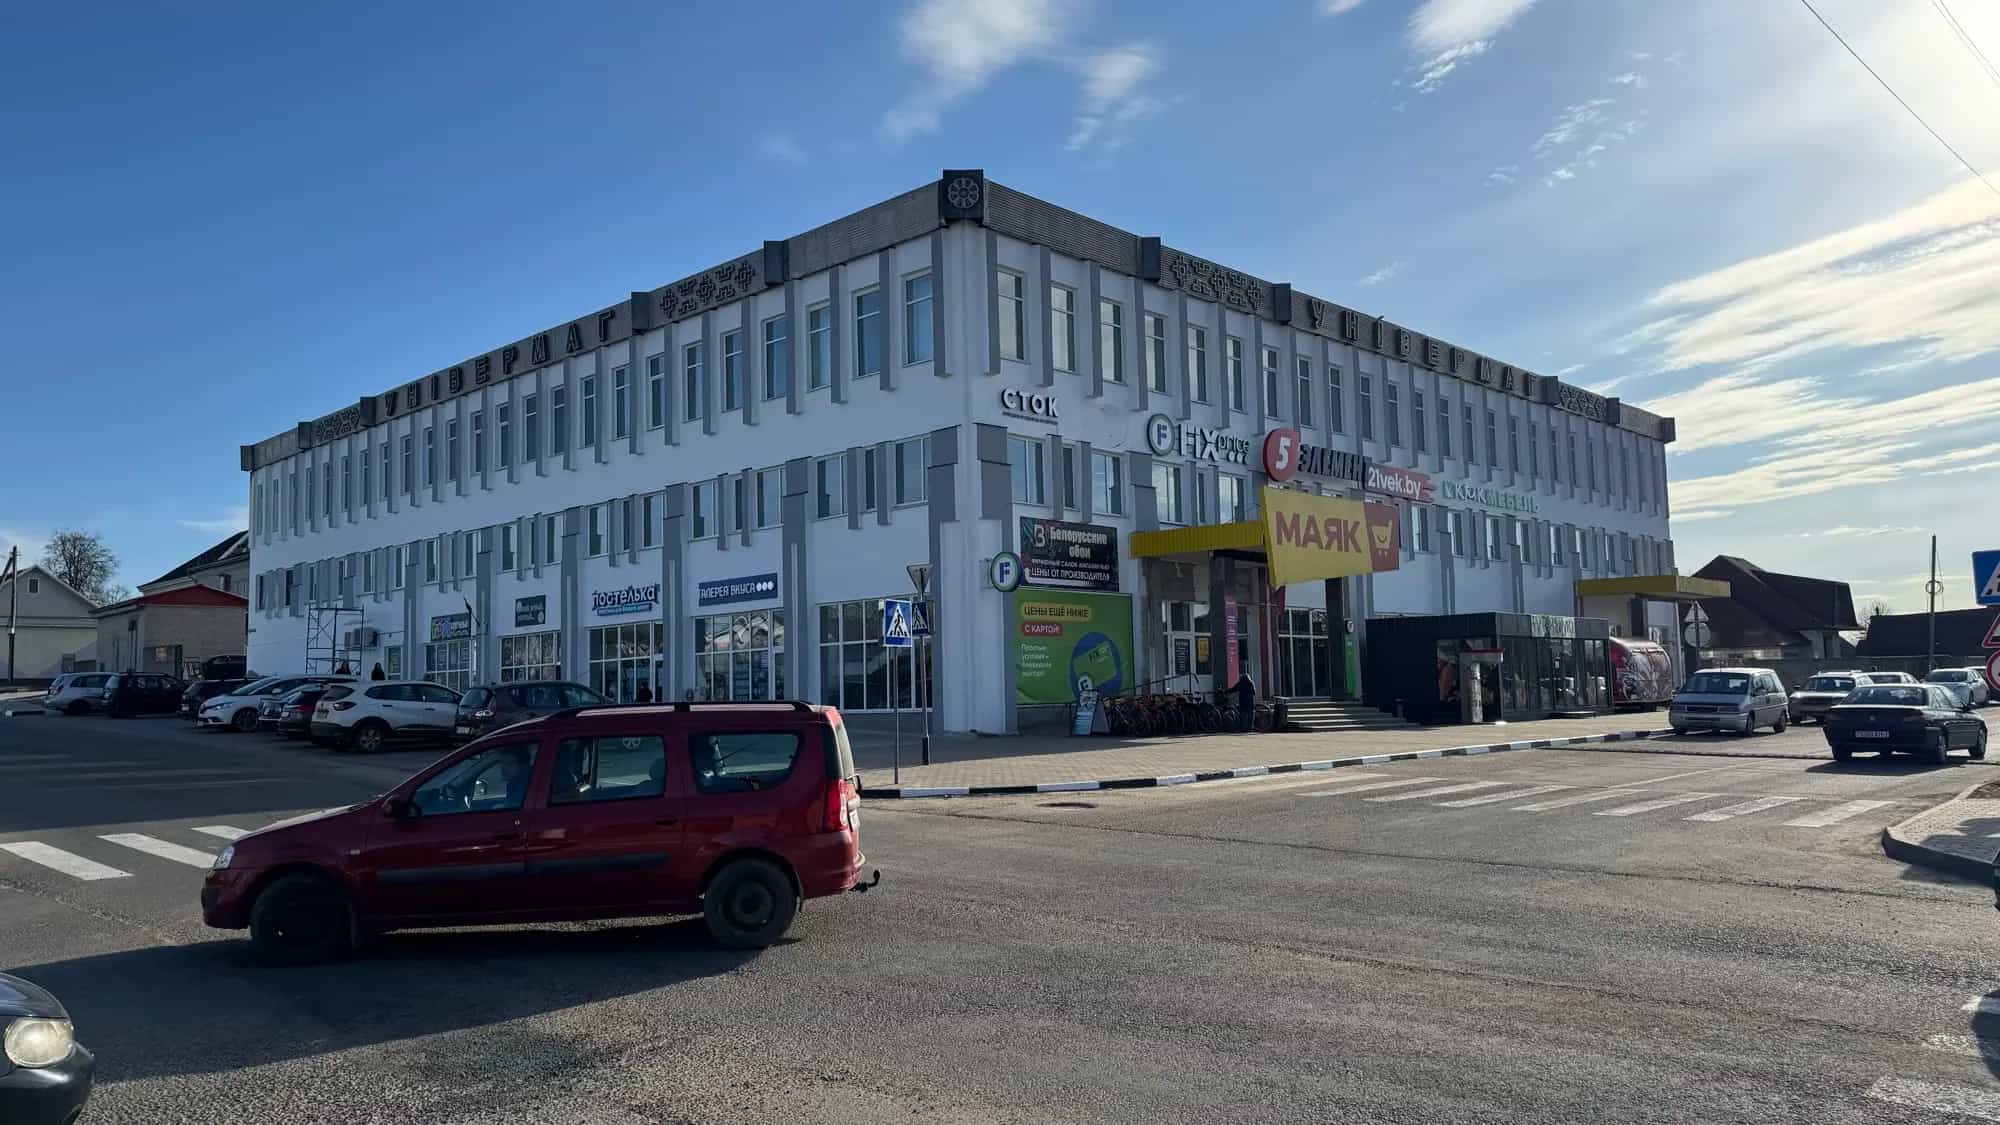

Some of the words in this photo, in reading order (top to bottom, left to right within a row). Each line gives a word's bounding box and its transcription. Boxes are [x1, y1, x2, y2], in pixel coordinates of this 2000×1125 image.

[384, 310, 615, 417] УНІВЕРМАГ
[1001, 388, 1058, 417] СТОК
[1179, 423, 1219, 462] FIX
[1275, 436, 1292, 470] 5
[1298, 443, 1372, 483] ЭЛЕМЕН
[1367, 466, 1422, 499] 21vek.by
[1050, 526, 1108, 546] Белорусские
[1275, 511, 1362, 554] МАЯК
[1069, 544, 1091, 559] обои
[1031, 567, 1052, 577] ЦЕНЫ
[1052, 569, 1062, 578] ОТ
